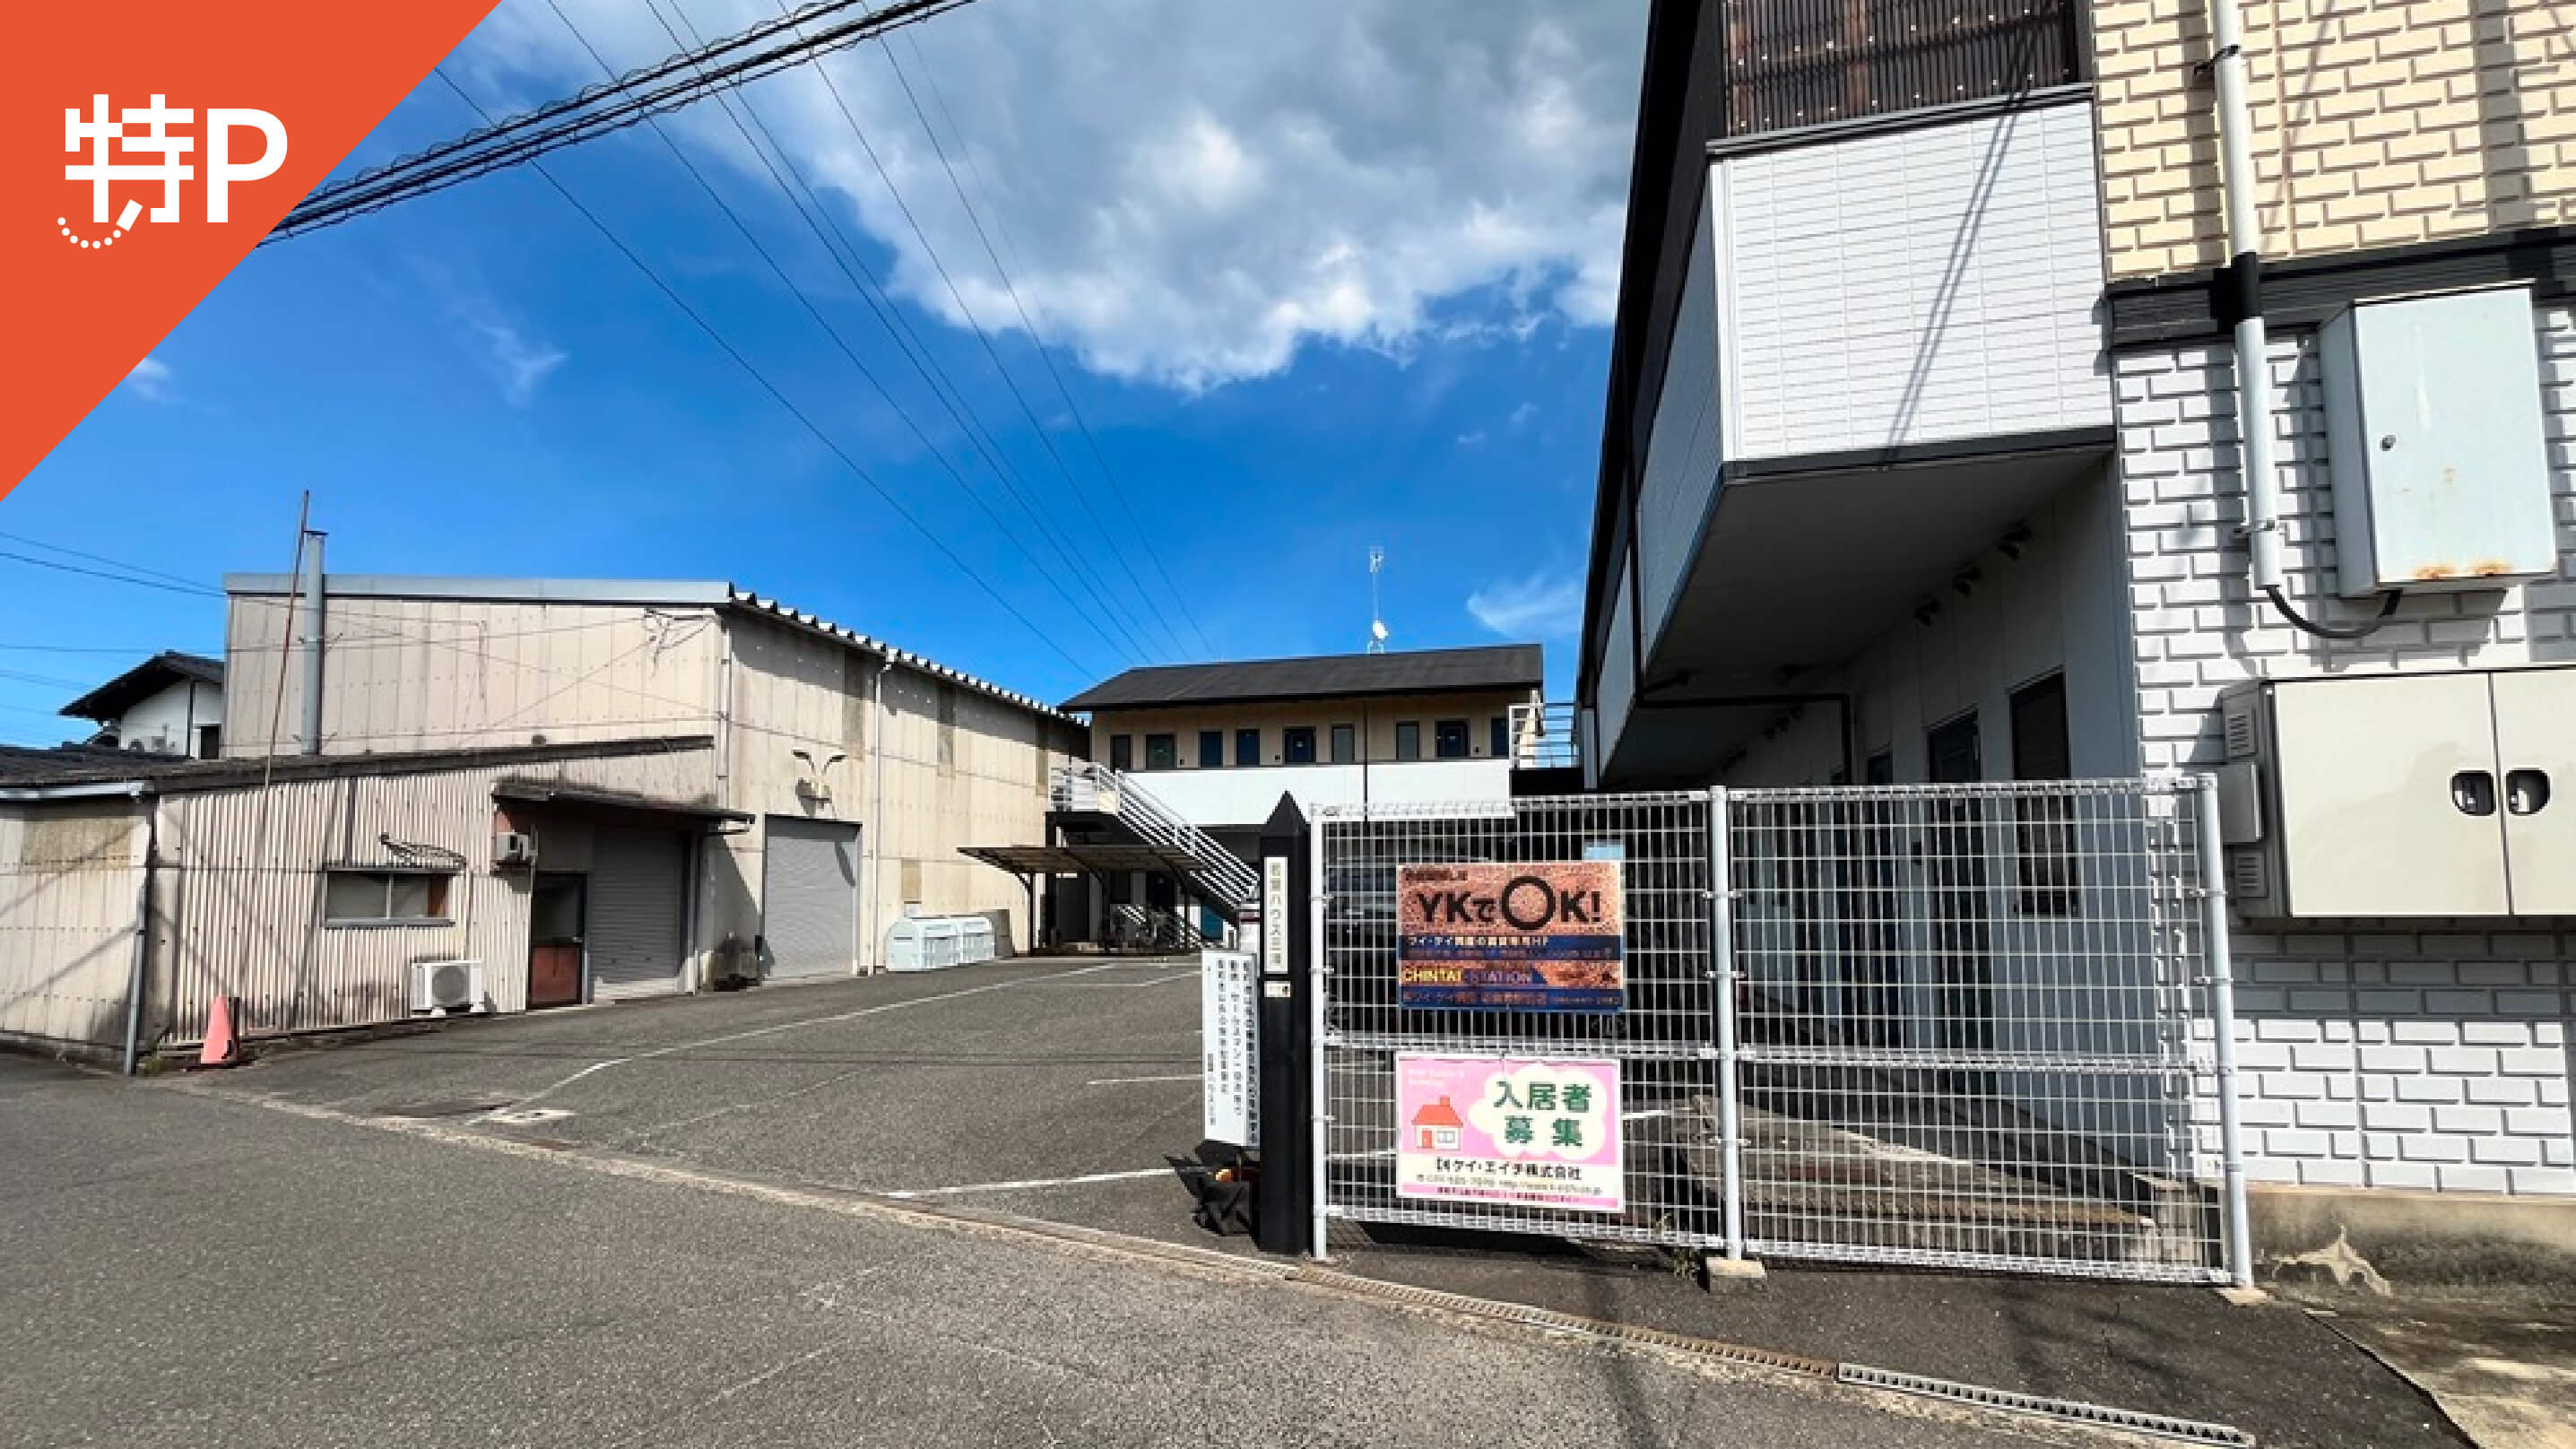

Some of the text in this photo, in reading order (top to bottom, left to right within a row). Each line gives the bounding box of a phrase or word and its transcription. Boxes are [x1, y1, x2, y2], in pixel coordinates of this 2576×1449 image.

[1416, 875, 1601, 931] YKでOK!
[1403, 968, 1462, 983] CHINTAI
[1493, 1080, 1592, 1113] 入居者
[1504, 1114, 1583, 1147] 募集
